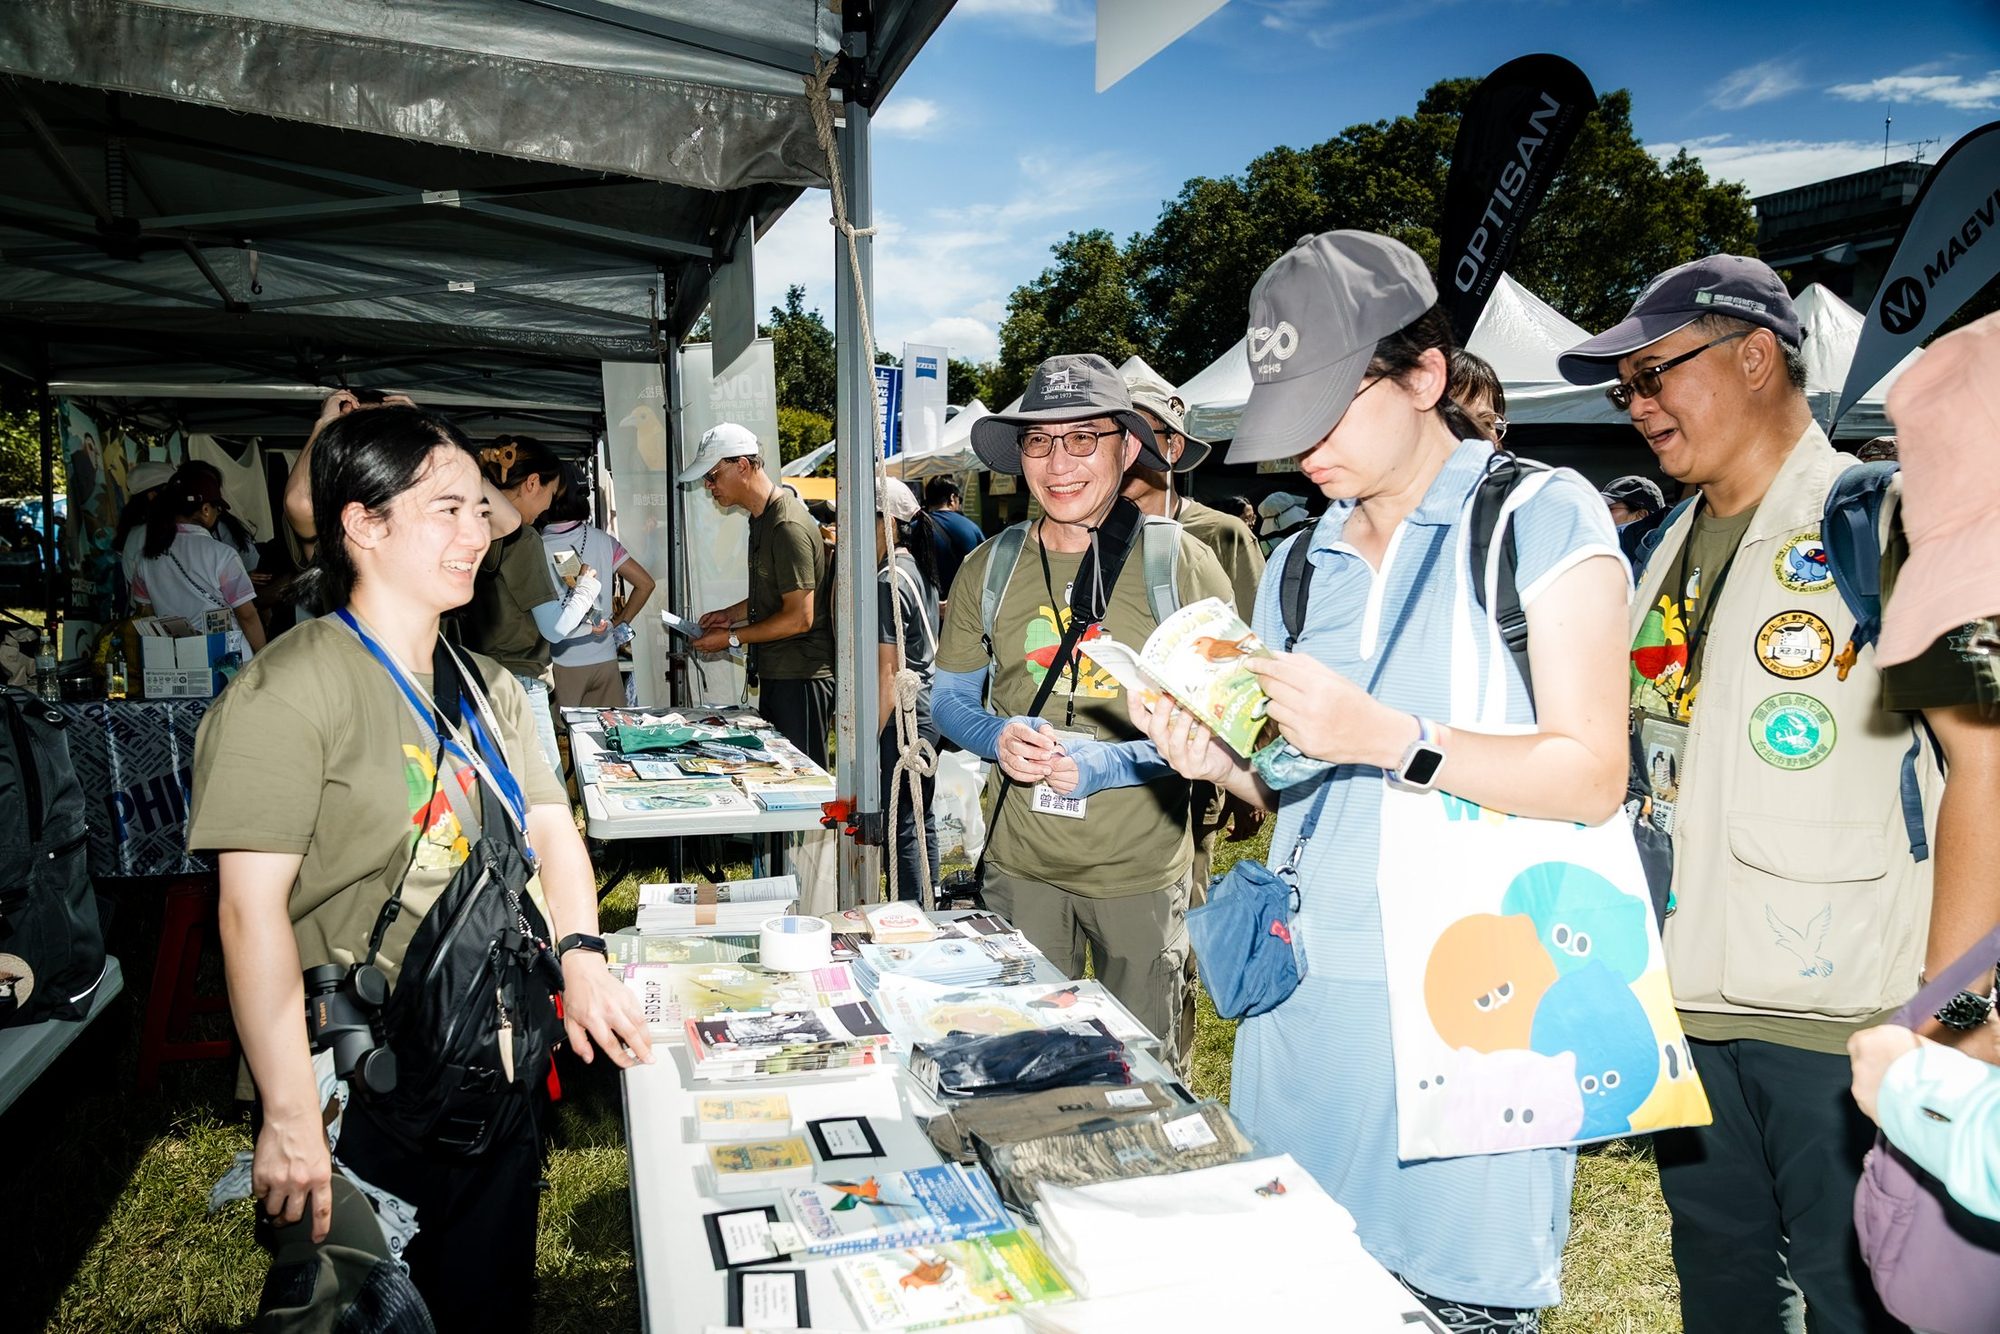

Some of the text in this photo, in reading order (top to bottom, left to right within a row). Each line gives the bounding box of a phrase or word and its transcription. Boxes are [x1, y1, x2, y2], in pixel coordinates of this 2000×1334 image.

[1455, 91, 1561, 292] OPTISAN
[1476, 222, 1517, 296] PRECISION
[84, 704, 140, 745] CLARK
[131, 842, 164, 875] CEBU
